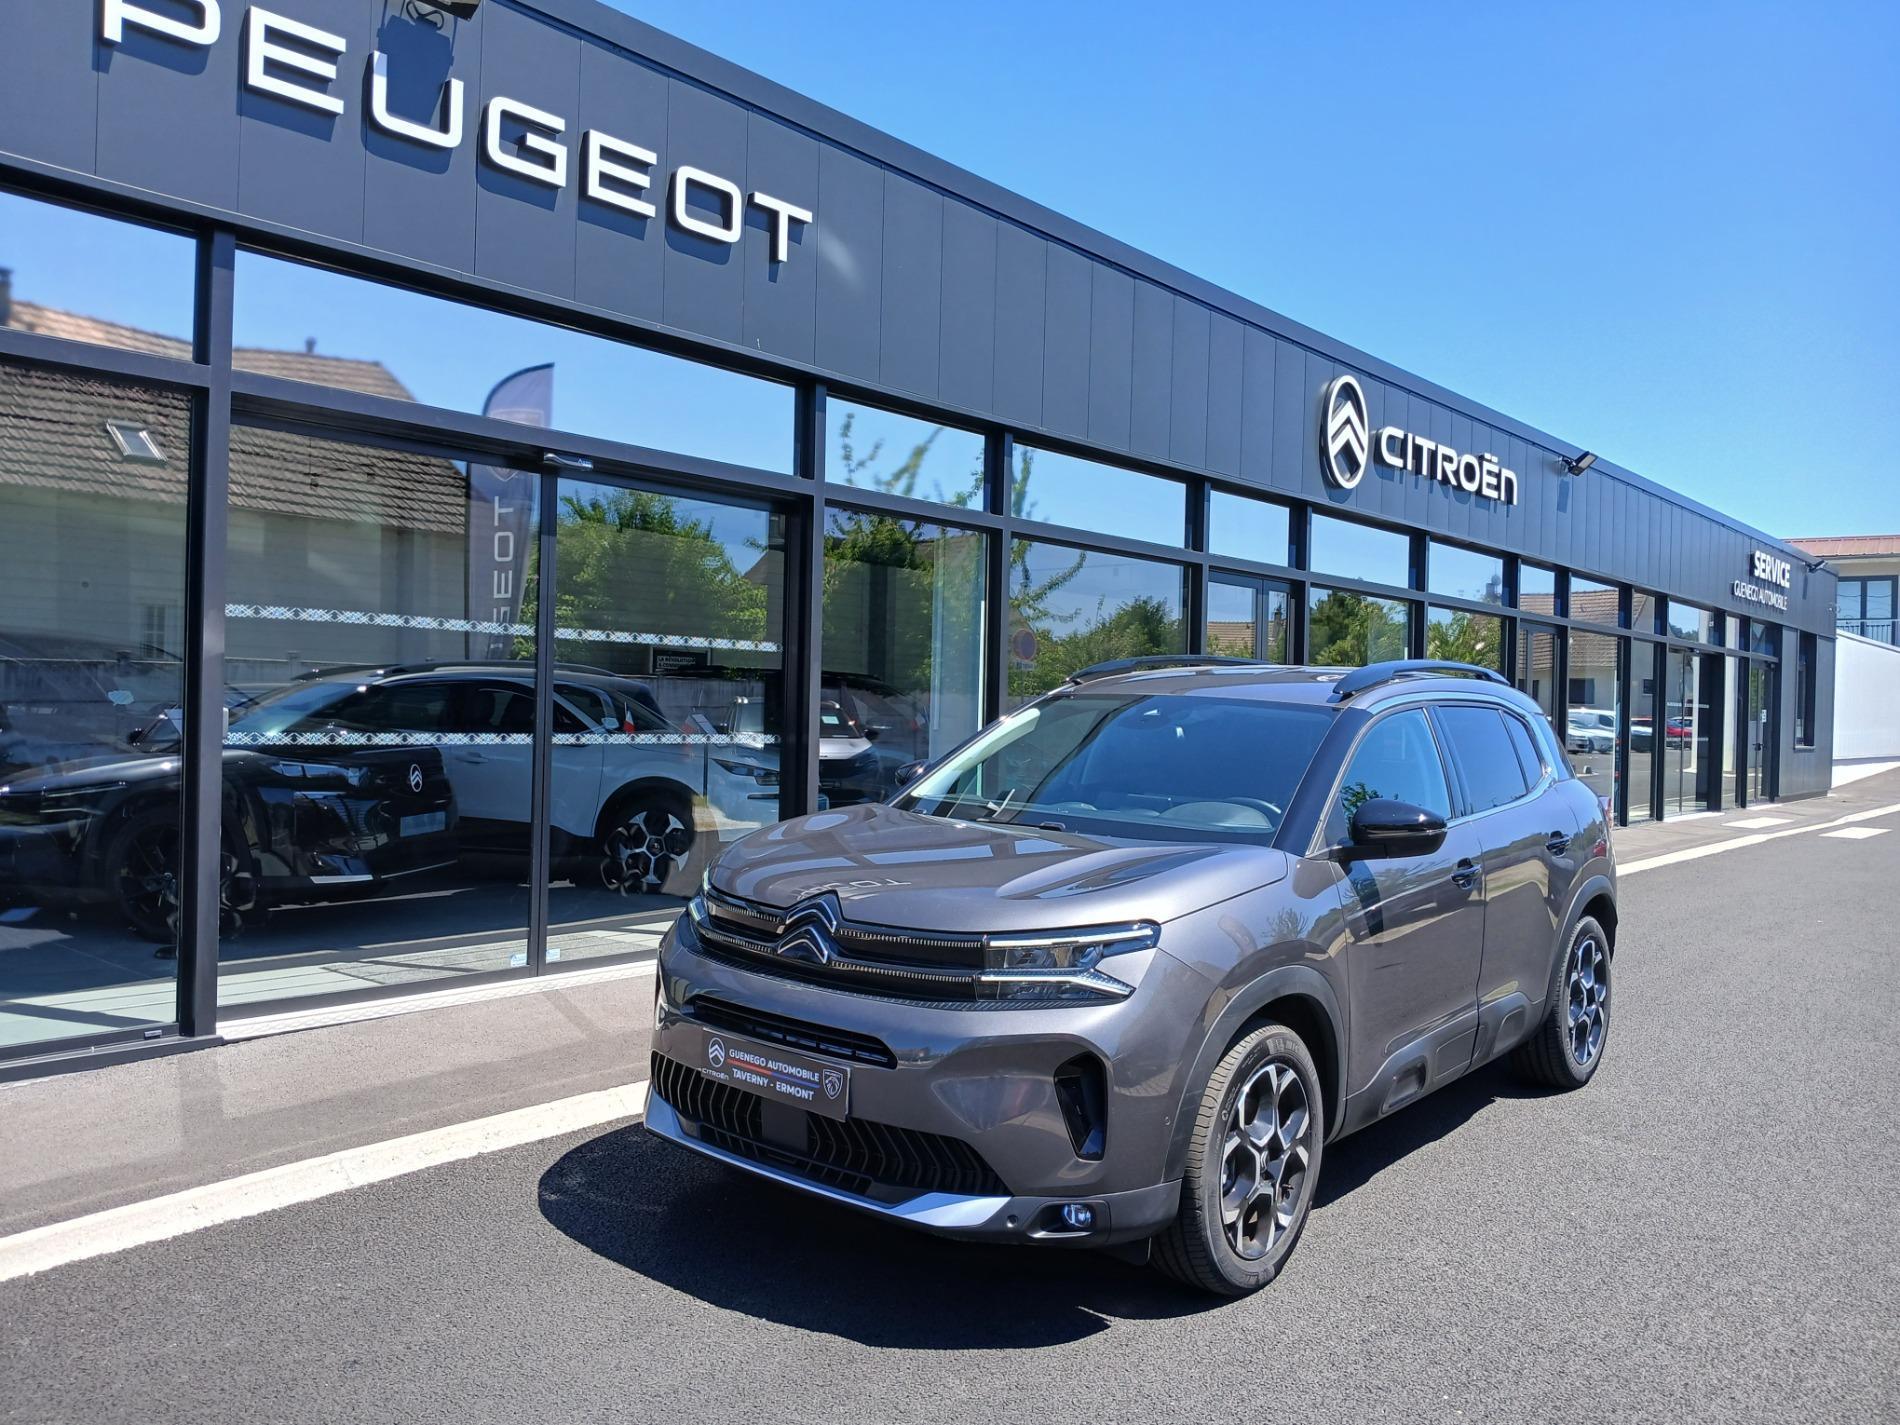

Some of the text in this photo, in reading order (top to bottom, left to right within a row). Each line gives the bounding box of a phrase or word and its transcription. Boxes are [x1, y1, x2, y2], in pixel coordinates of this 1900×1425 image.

[104, 0, 813, 263] PEUGEOT
[1754, 550, 1791, 589] SERVICE
[1759, 588, 1788, 611] AUTOMOBILE
[729, 1049, 820, 1082] GUENEGO AUTOMOBILE
[732, 1068, 769, 1088] TAVERNY
[776, 1081, 815, 1101] ERMONT
